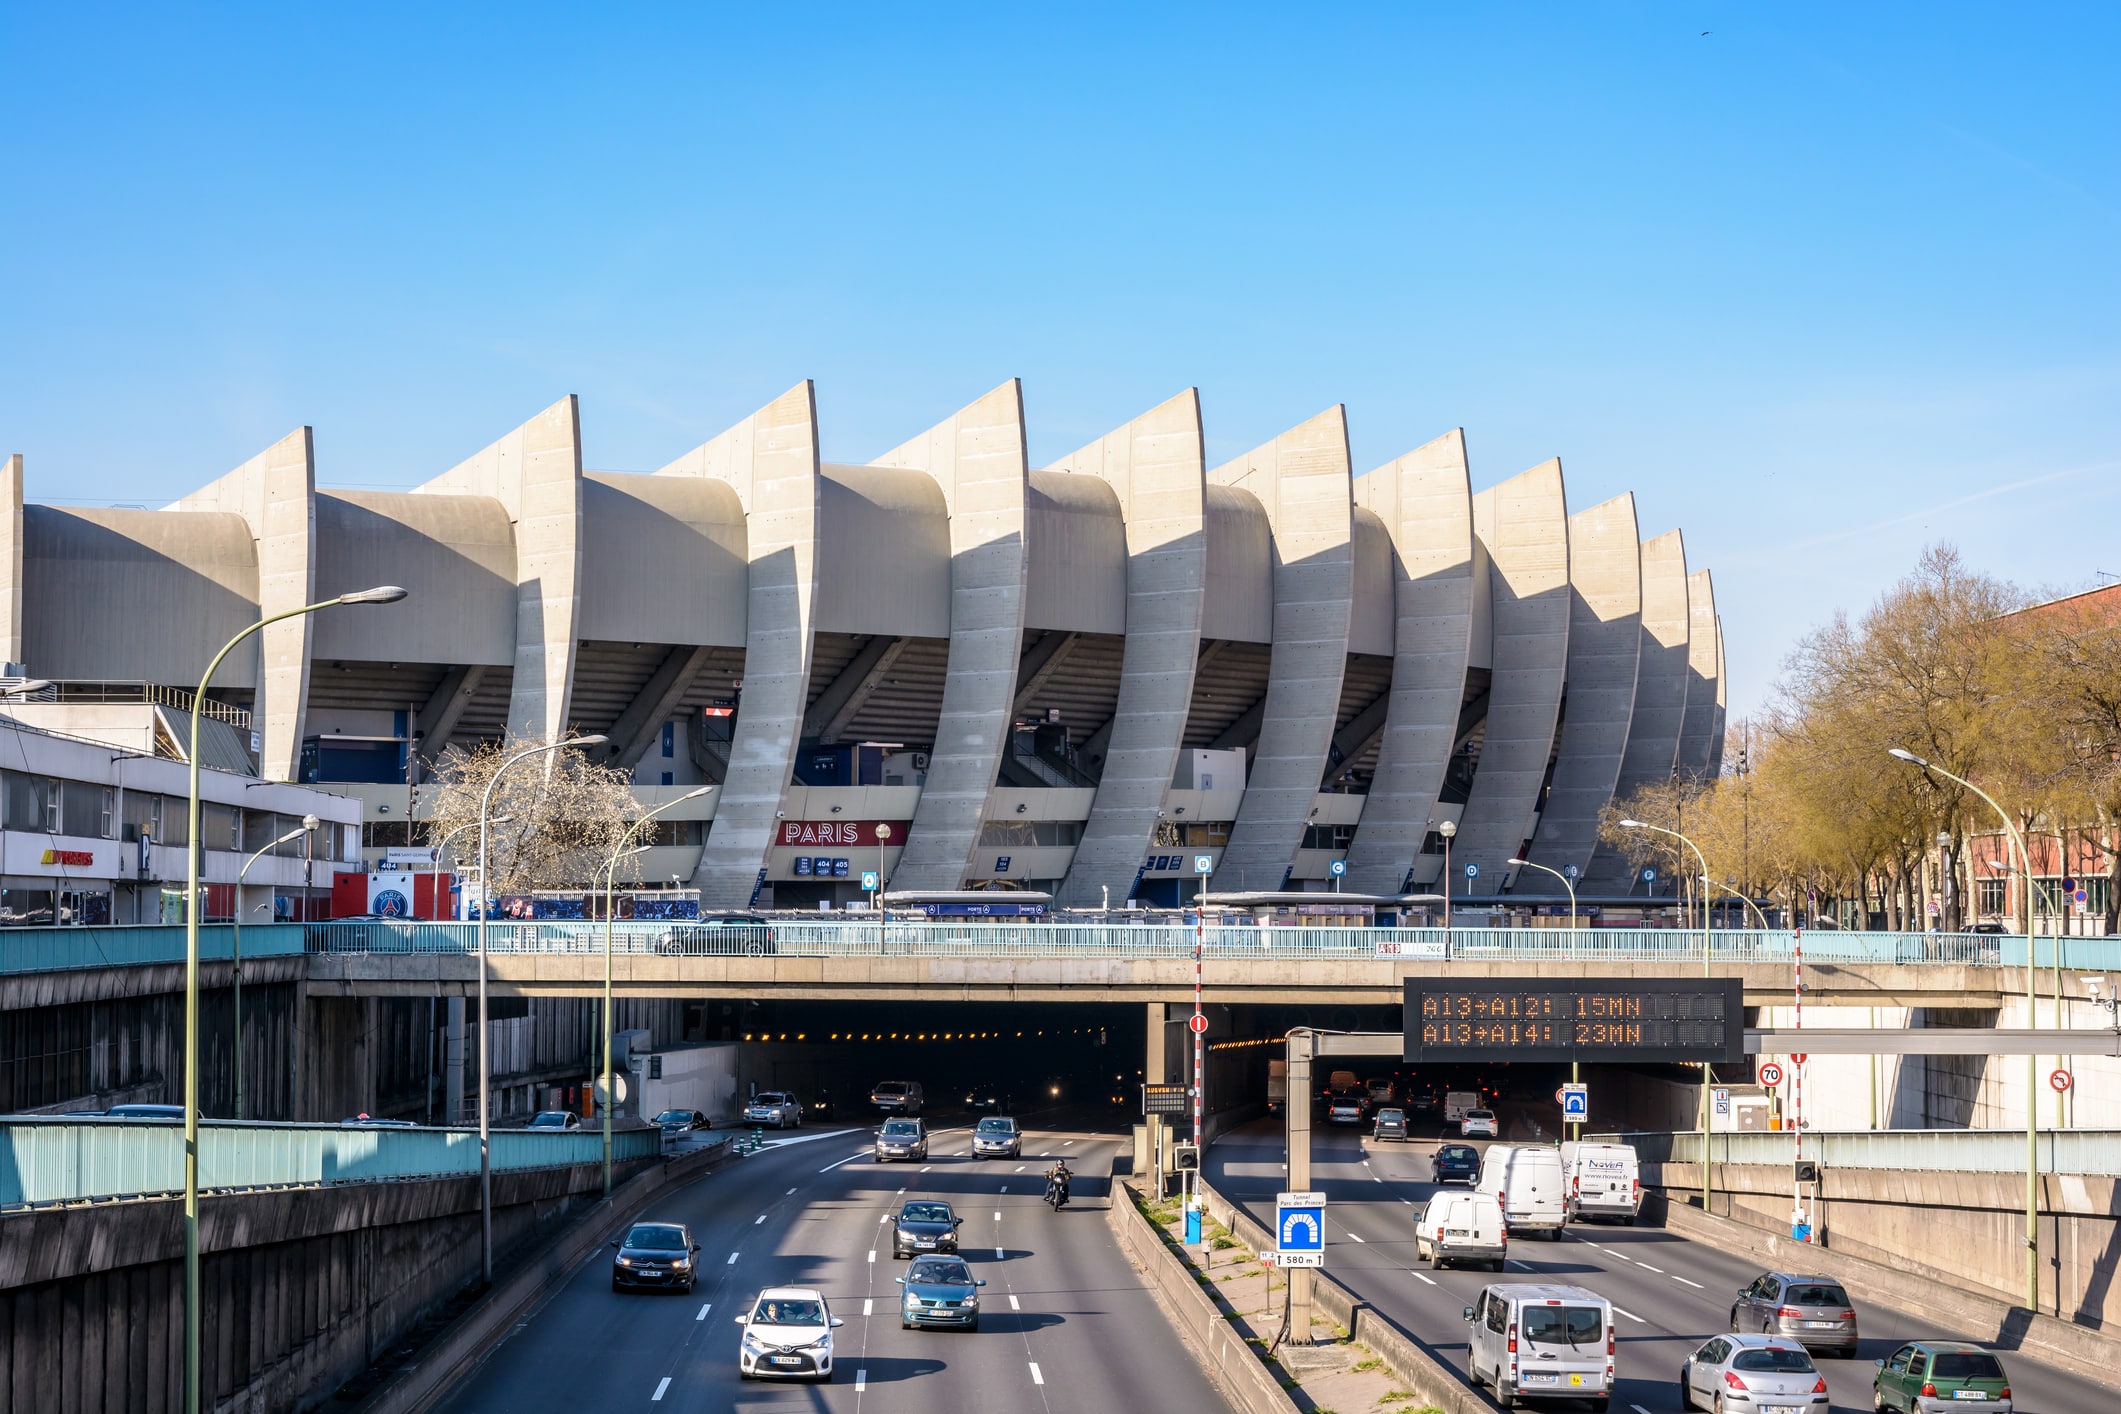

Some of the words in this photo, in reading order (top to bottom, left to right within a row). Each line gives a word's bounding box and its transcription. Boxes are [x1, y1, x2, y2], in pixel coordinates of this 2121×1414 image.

[785, 823, 858, 843] PARIS
[1334, 864, 1341, 872] C
[1423, 997, 1471, 1016] A13
[1577, 997, 1640, 1016] 15MN
[1423, 1023, 1471, 1043] A13
[1576, 1023, 1640, 1043] 23MN
[1764, 1070, 1779, 1080] 70
[1286, 1256, 1304, 1264] 580
